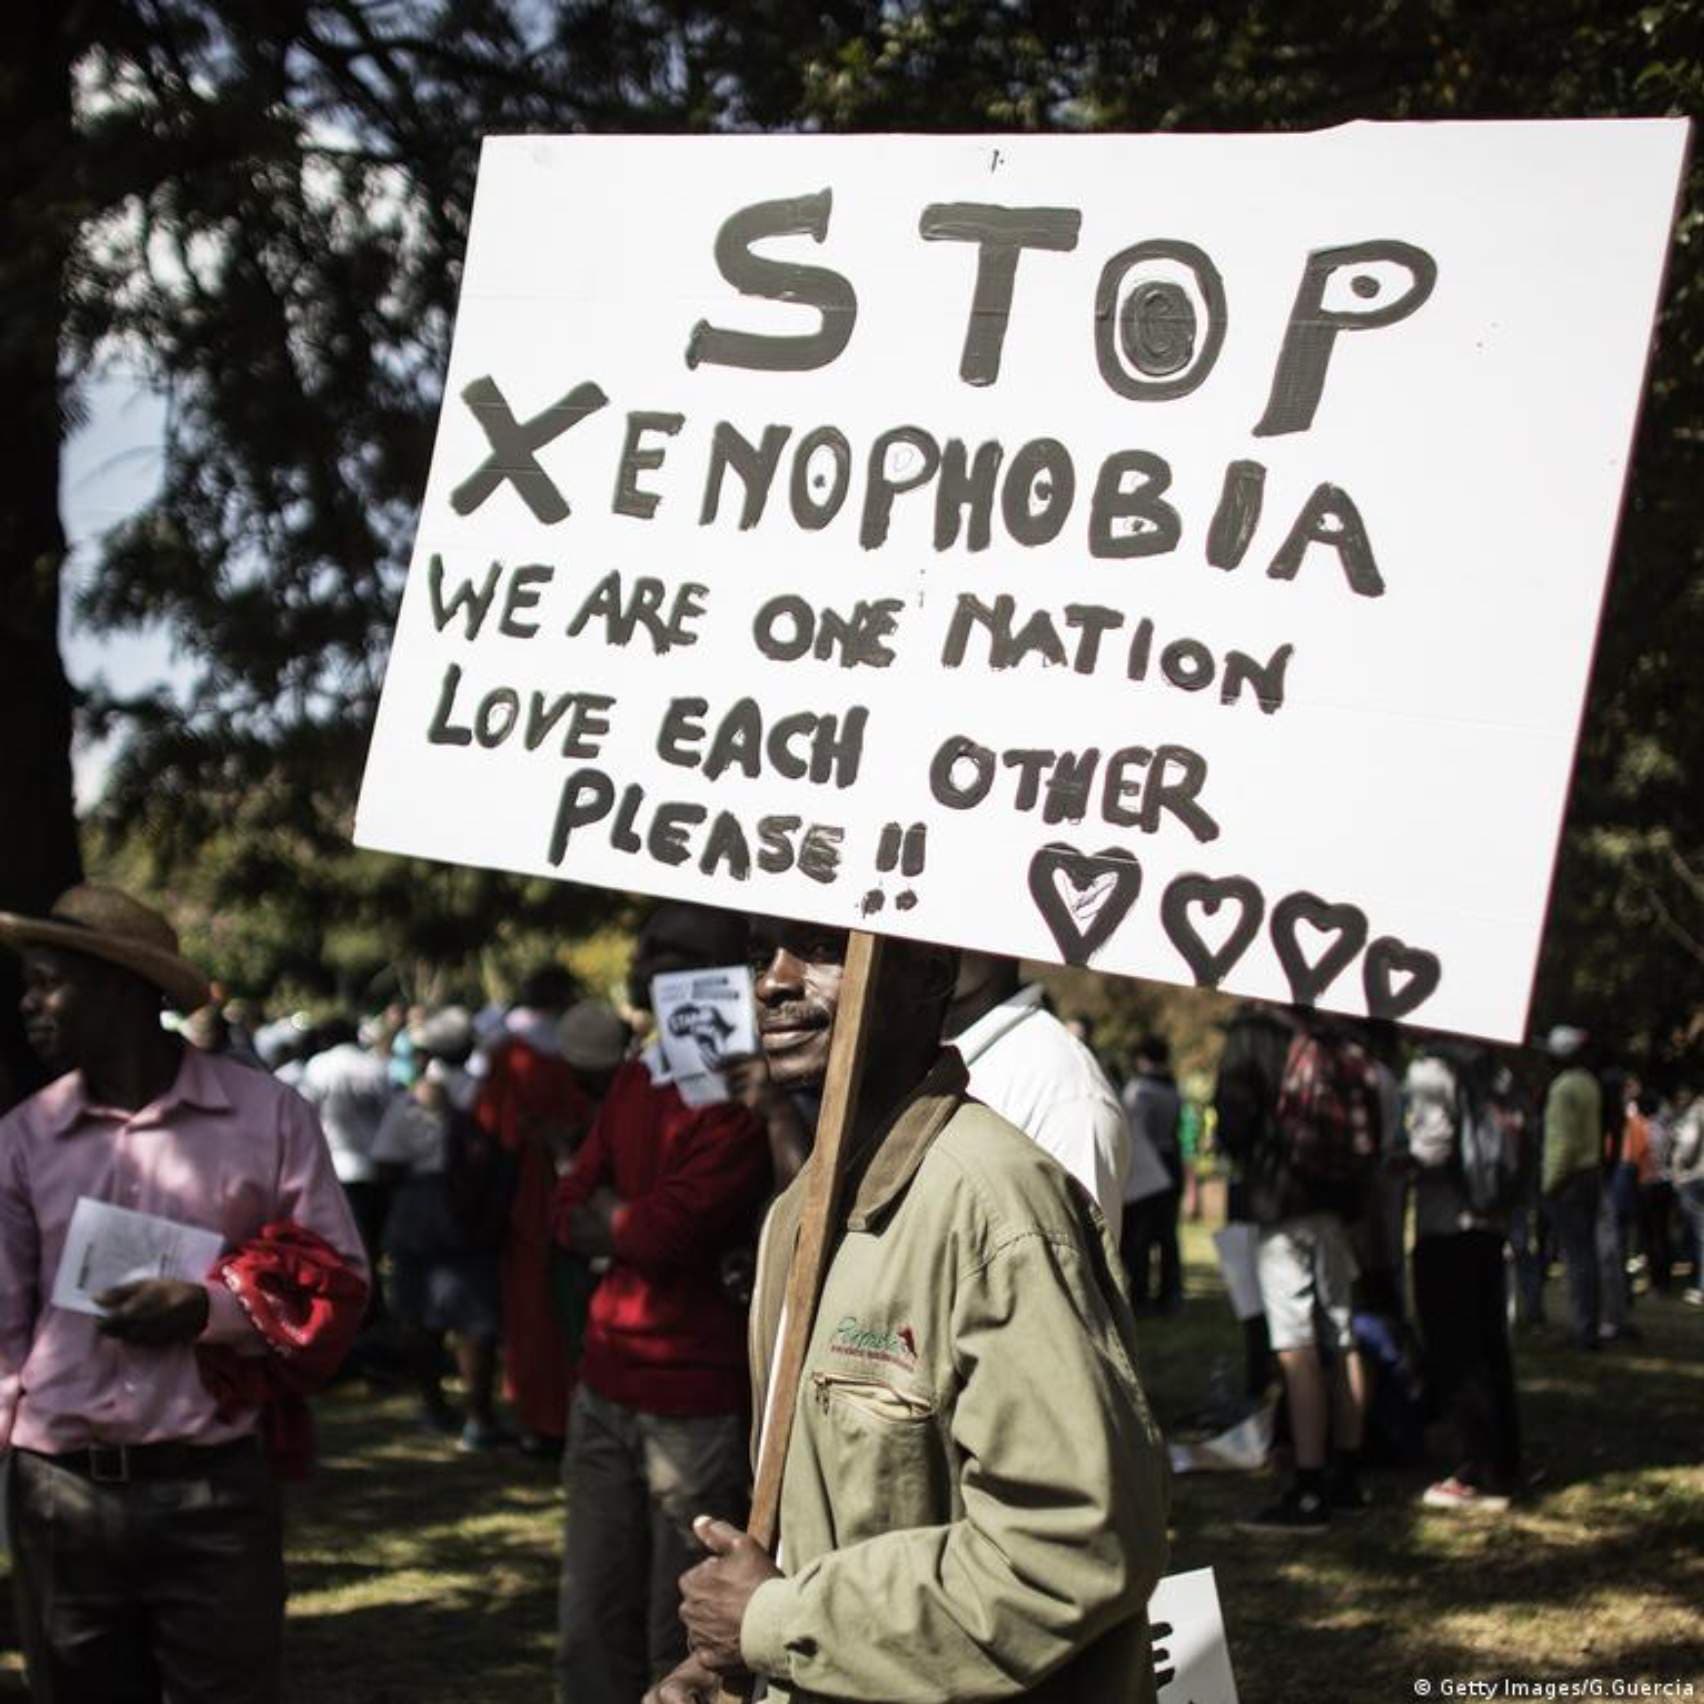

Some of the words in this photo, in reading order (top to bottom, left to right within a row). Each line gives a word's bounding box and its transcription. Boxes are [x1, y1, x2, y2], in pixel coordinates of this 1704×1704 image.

[684, 188, 1438, 438] STOP
[450, 375, 1386, 599] XENOPHOBIA
[428, 553, 555, 642] WE
[565, 569, 710, 656] ARE
[752, 594, 906, 669] ONE
[941, 593, 1294, 715] NATION
[427, 662, 617, 760] LOVE
[656, 696, 870, 790] EACH
[929, 735, 1220, 844] OTHER
[547, 767, 845, 885] PLEASE
